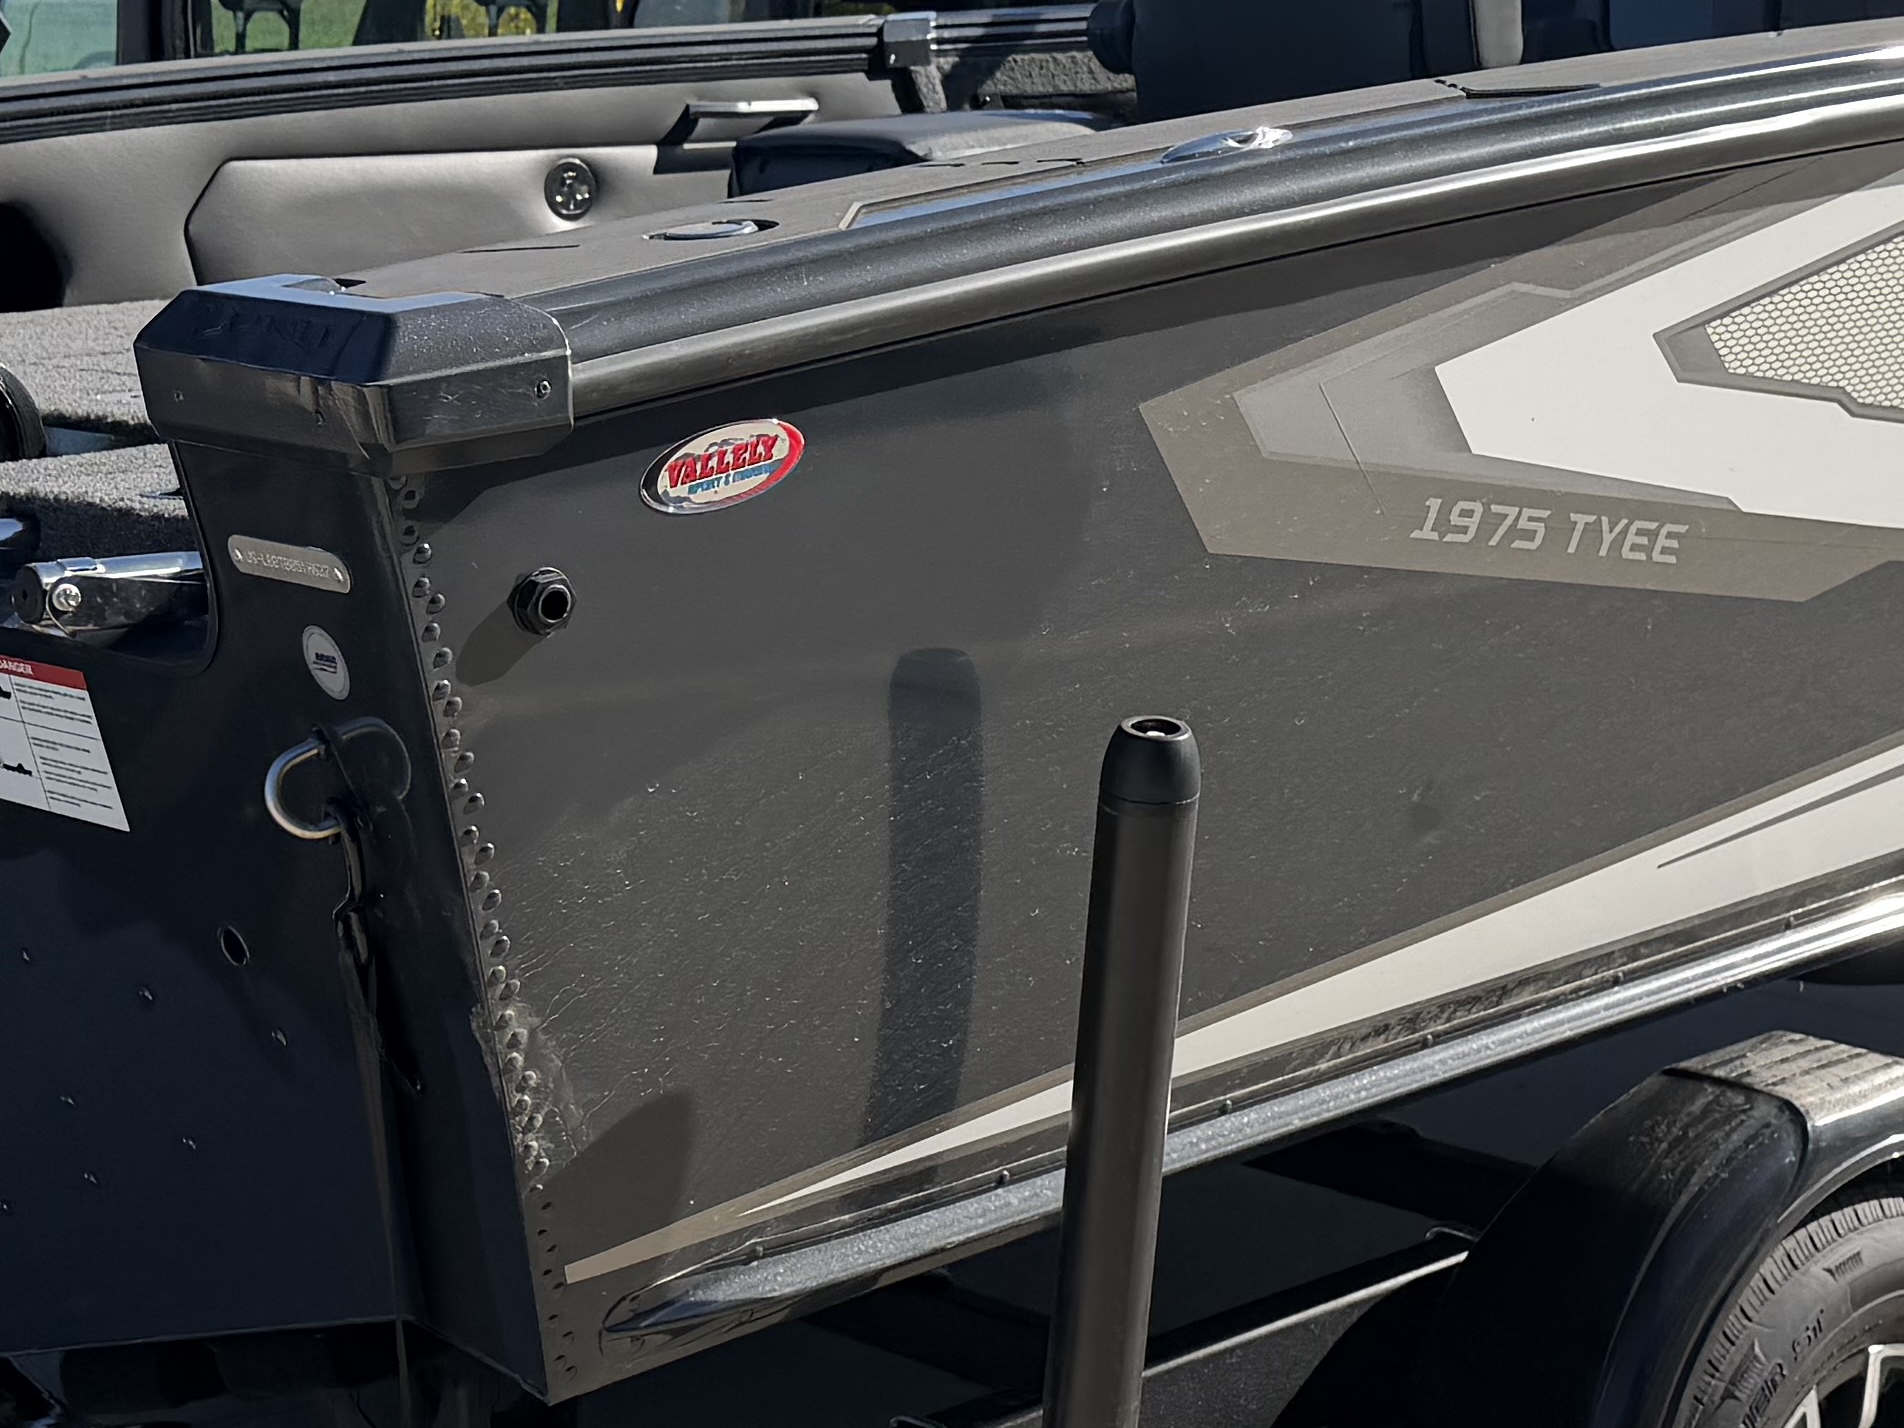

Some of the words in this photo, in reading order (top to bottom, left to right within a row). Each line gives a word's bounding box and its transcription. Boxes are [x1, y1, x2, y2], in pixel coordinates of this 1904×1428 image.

[665, 434, 779, 489] VALLELY
[1409, 496, 1553, 554] 1975
[1567, 511, 1691, 566] TYEE
